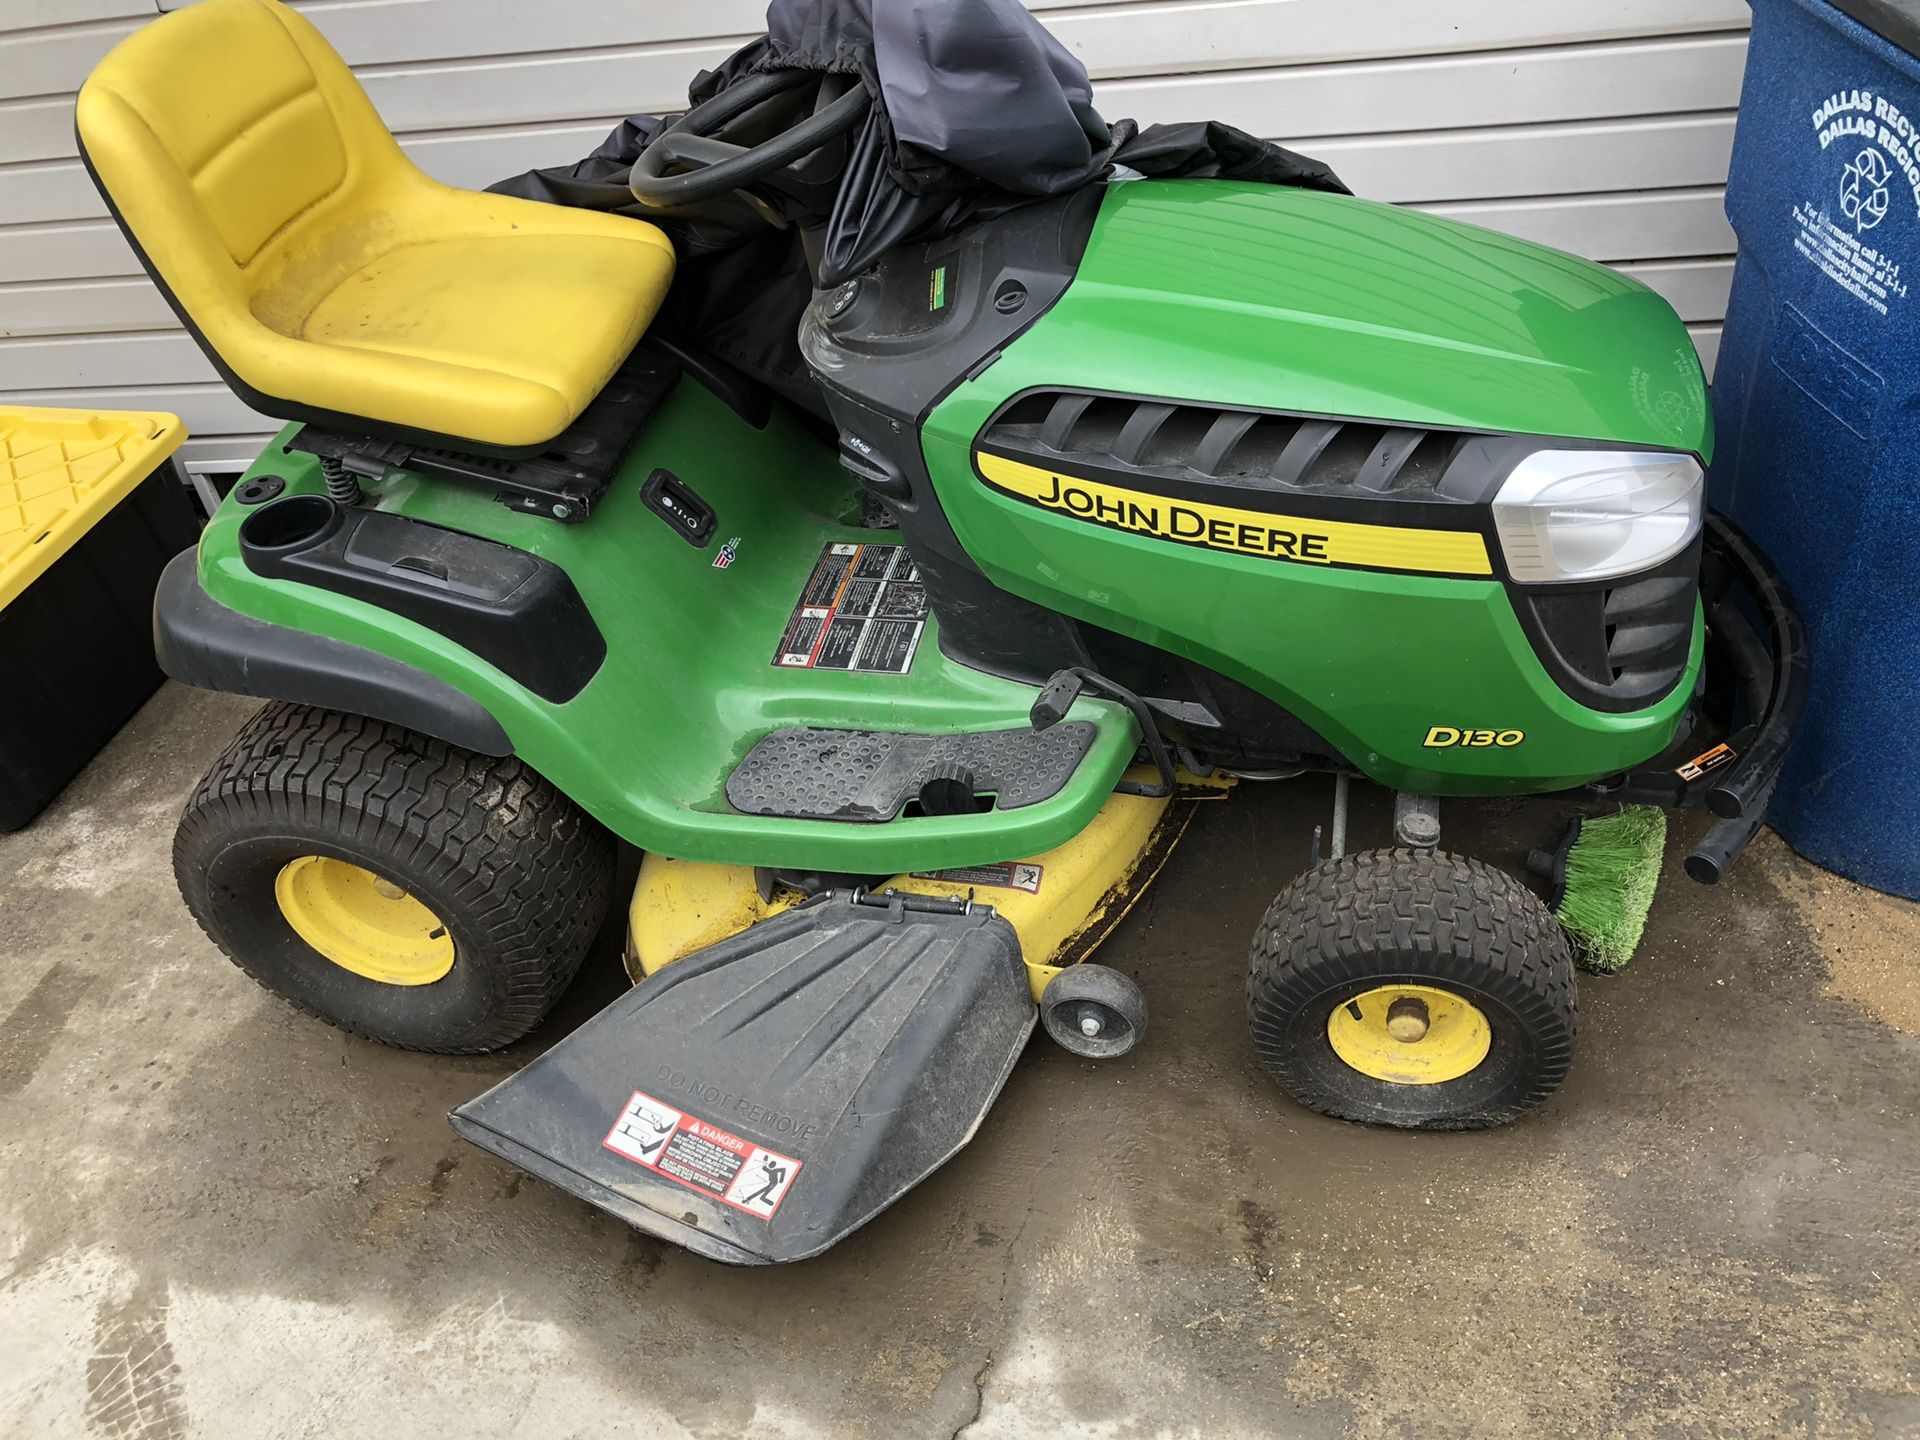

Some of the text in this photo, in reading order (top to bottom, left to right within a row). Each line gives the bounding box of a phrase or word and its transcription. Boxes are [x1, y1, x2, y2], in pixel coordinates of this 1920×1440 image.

[1812, 89, 1872, 130] DALLAS
[1818, 116, 1920, 218] DALLAS RECICL
[1792, 205, 1809, 227] Para
[1851, 251, 1875, 276] llame
[1875, 270, 1885, 282] al
[1884, 275, 1907, 298] 3-1-1
[1804, 200, 1818, 219] For
[1861, 246, 1878, 262] call
[1877, 254, 1900, 278] 3-1-1
[1038, 477, 1329, 560] JOHN DEERE
[1422, 726, 1526, 747] D130
[655, 1064, 818, 1141] DO NOT REMOVE
[701, 1125, 744, 1151] DANGER
[687, 1133, 715, 1150] ROTATING
